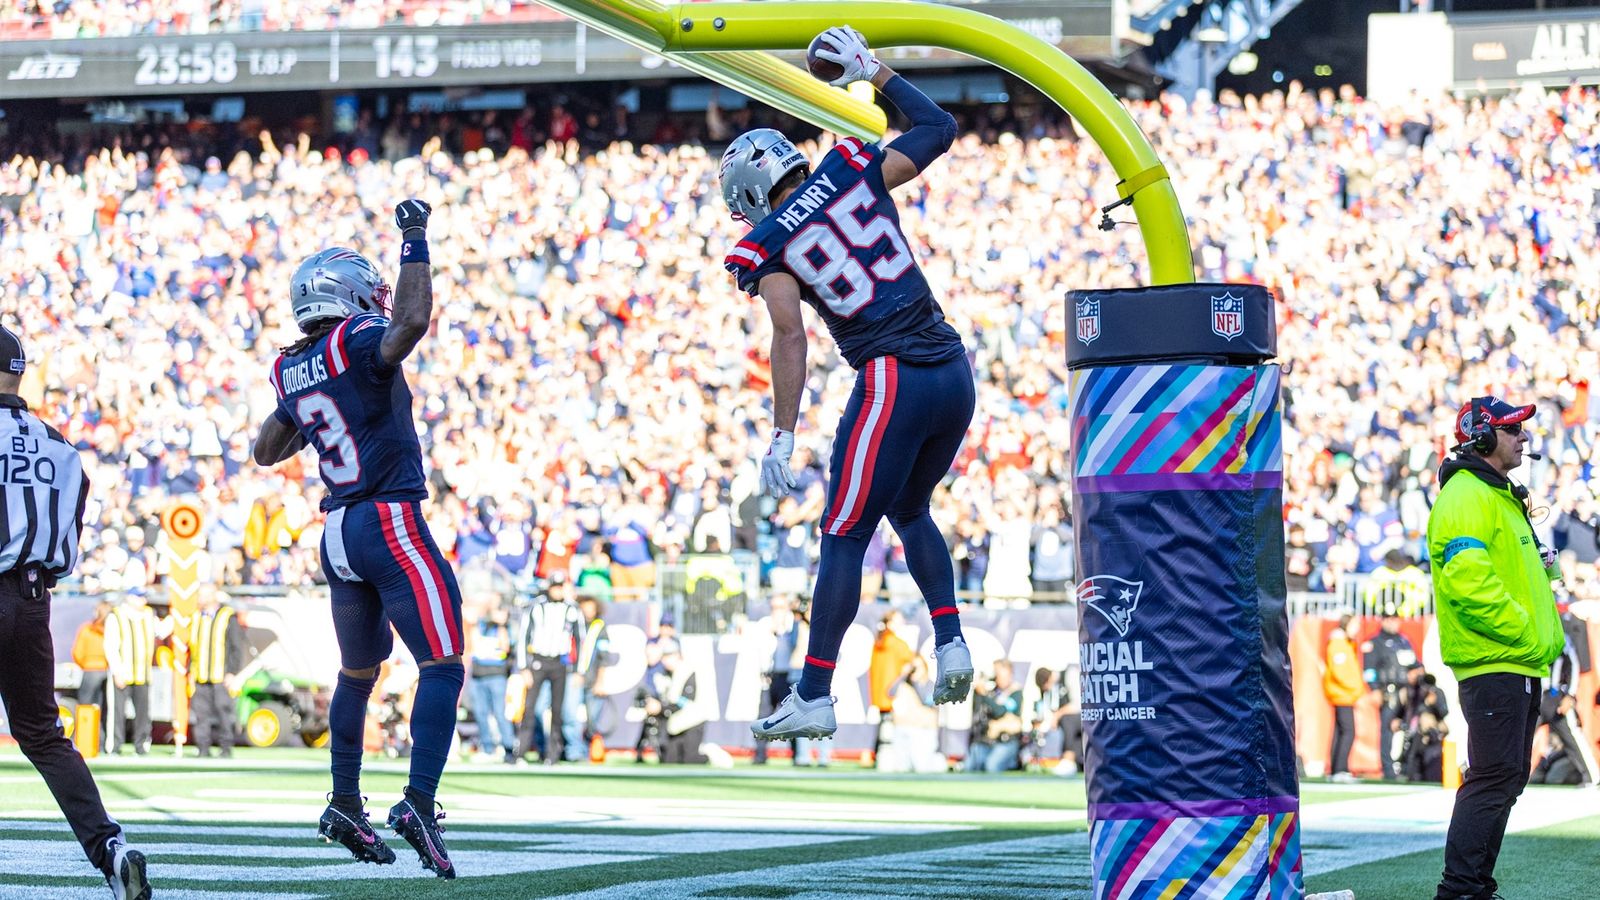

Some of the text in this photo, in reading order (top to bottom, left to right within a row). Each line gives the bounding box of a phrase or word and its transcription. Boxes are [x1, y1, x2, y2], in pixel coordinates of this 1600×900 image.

[7, 53, 82, 80] JETS
[135, 42, 238, 85] 23:58
[373, 35, 439, 78] 143
[771, 141, 792, 158] 85
[776, 172, 838, 233] HENRY
[782, 177, 915, 319] 85
[300, 283, 308, 296] 3
[1078, 316, 1098, 338] NFL
[1216, 313, 1241, 331] NFL
[282, 354, 328, 395] DOUGLAS
[12, 436, 39, 454] BJ
[297, 390, 361, 486] 3
[1080, 641, 1153, 672] RUCIAL
[1081, 706, 1156, 720] ERCEPT CANCER
